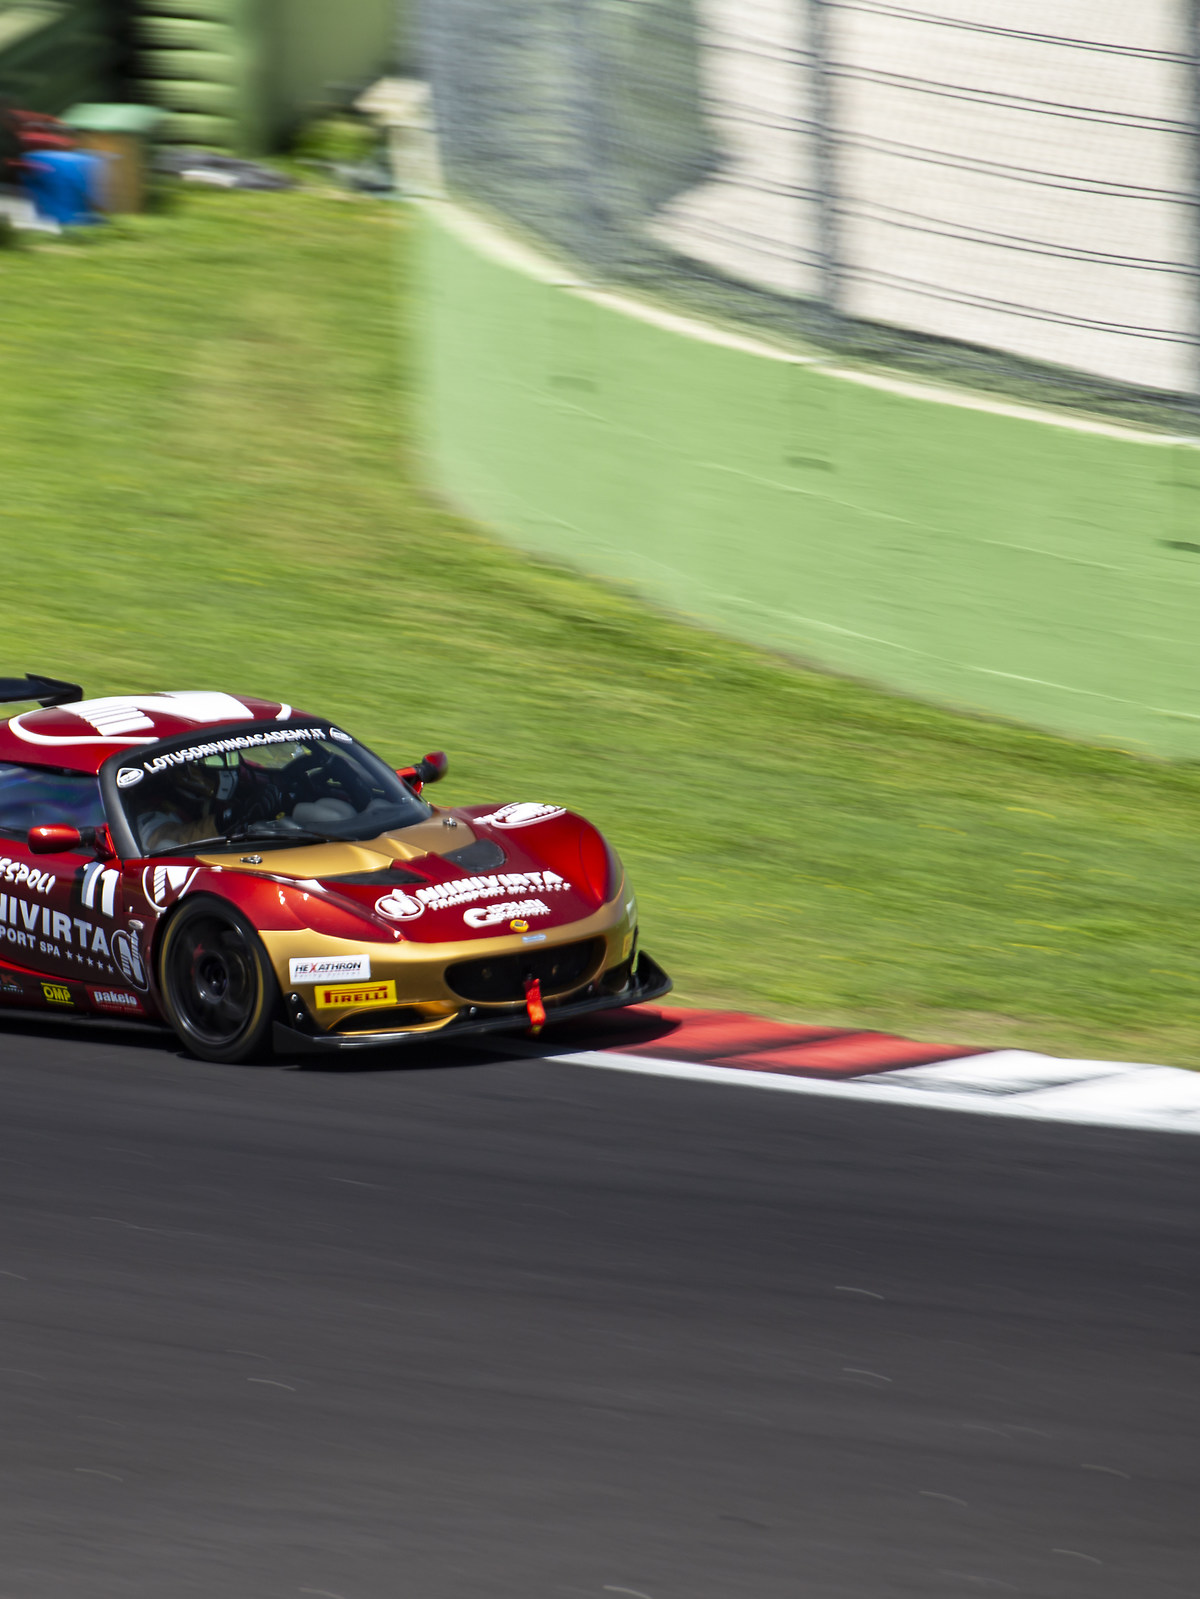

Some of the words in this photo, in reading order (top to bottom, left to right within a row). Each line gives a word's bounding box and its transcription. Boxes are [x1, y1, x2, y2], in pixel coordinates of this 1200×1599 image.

[143, 728, 326, 774] LOTUSDRIVINGACADEMY.IT
[81, 861, 120, 918] 11
[415, 870, 564, 904] NIINIVIRTA
[39, 941, 61, 957] SPA
[295, 961, 362, 973] HEXATHRON
[43, 986, 71, 1002] OMP
[93, 990, 137, 1006] pakelo
[324, 986, 388, 1004] PIRELLI
